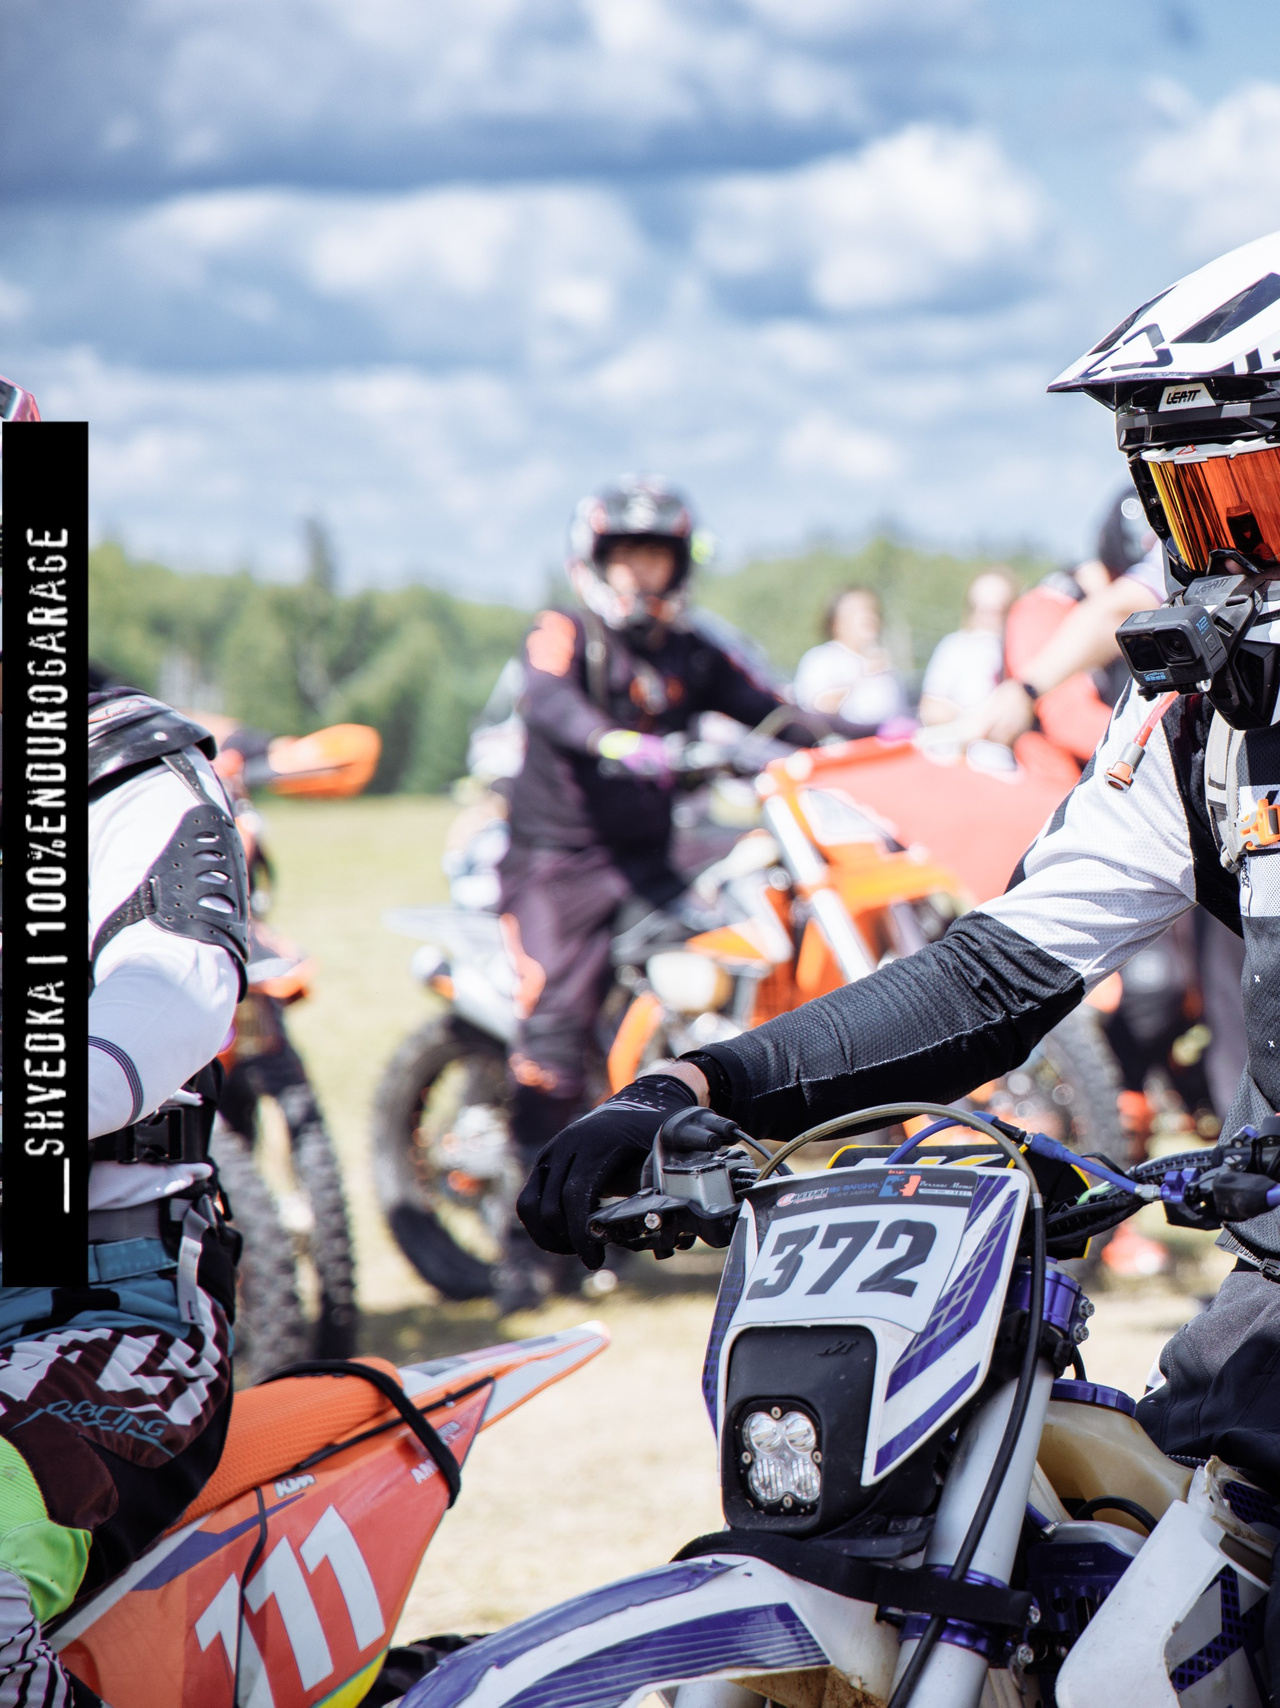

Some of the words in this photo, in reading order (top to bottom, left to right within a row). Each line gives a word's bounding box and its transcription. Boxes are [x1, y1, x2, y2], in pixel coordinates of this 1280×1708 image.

[1165, 388, 1201, 406] LEATT
[1195, 615, 1209, 632] 12
[746, 1219, 938, 1300] 372
[194, 1504, 387, 1708] 111
